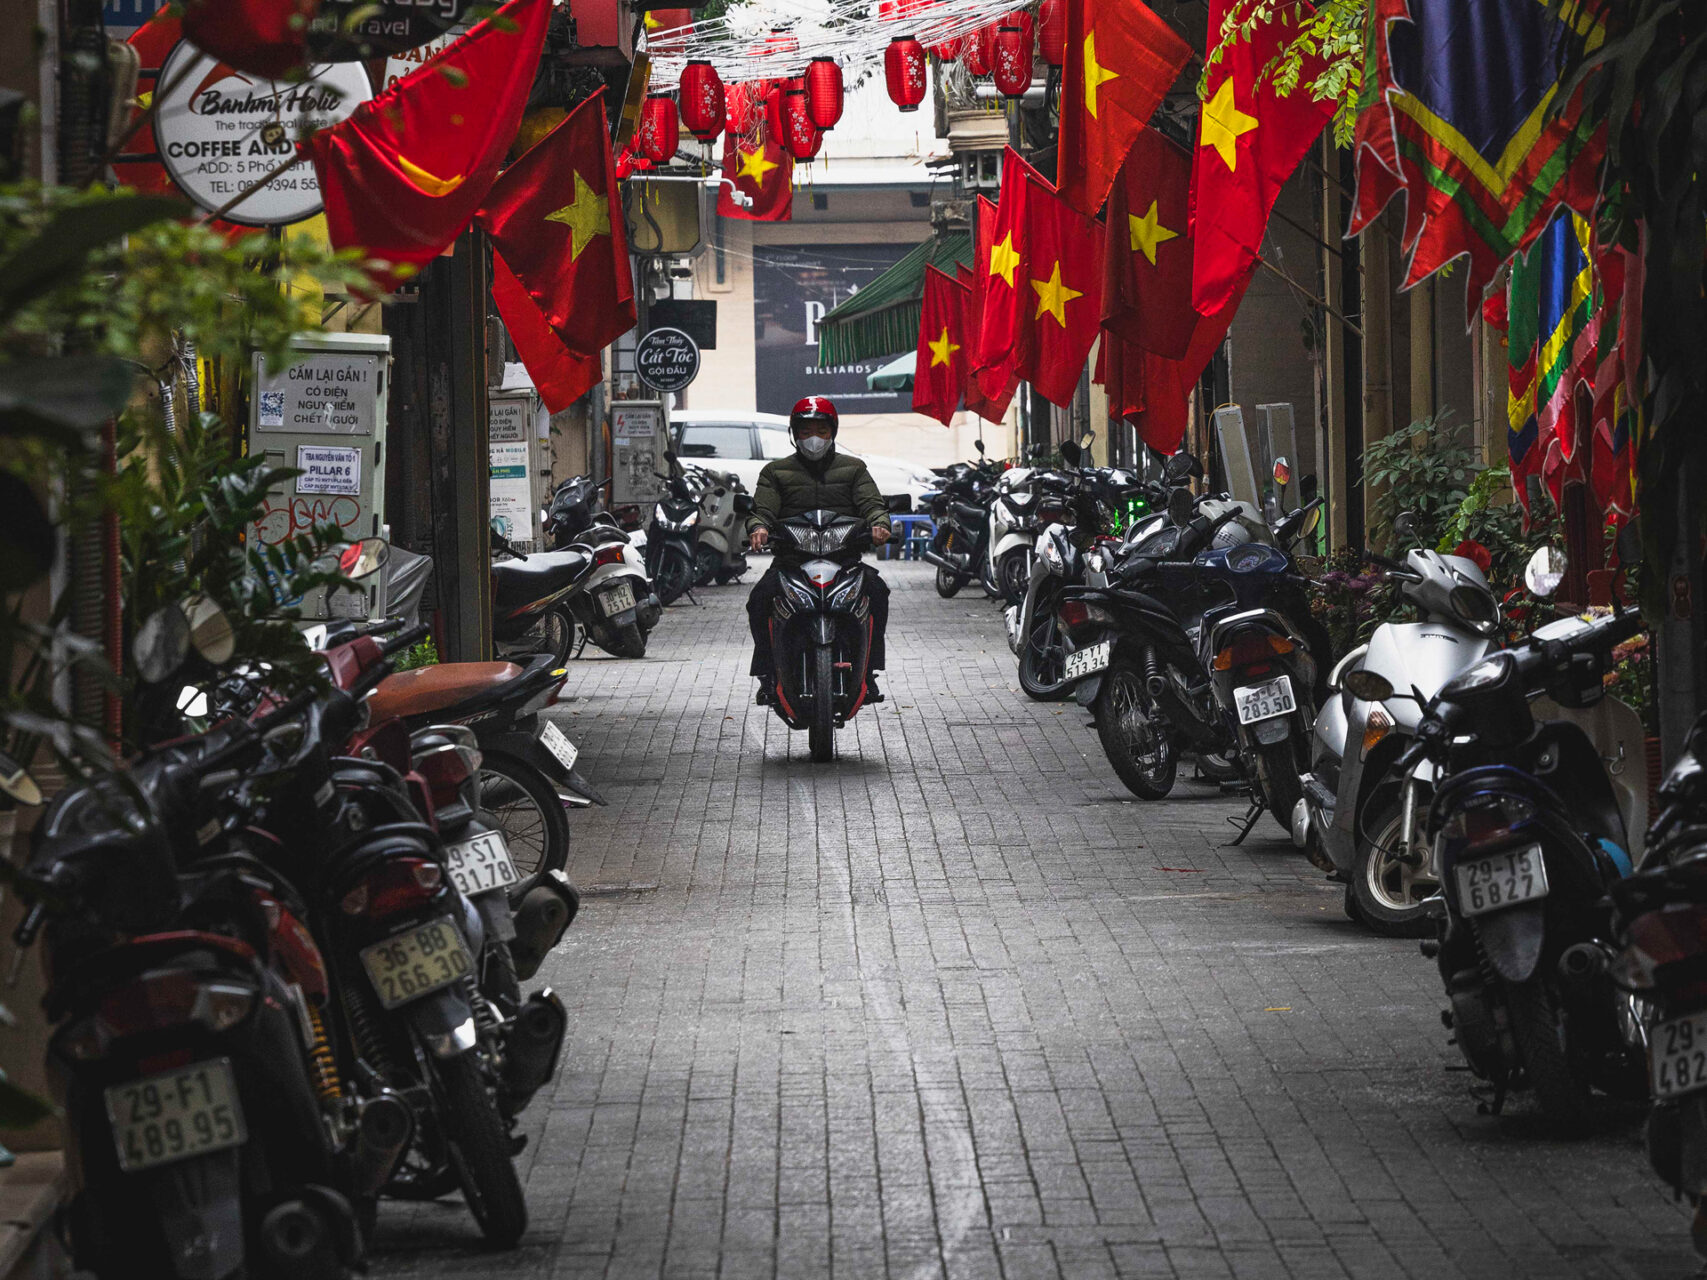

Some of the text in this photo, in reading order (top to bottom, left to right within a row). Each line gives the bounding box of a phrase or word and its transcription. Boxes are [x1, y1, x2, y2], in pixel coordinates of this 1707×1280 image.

[215, 120, 236, 131] The
[167, 140, 242, 159] COFFEE
[197, 162, 233, 174] ADD:
[236, 161, 246, 173] 5
[249, 158, 276, 173] Phố
[209, 180, 234, 193] TEL:
[300, 177, 321, 191] 55
[288, 364, 313, 381] CẤM
[316, 369, 334, 384] LẠI
[805, 365, 872, 375] BILLIARDS
[305, 385, 348, 399] CÓ ĐIỆN
[293, 412, 322, 424] CHẾT
[310, 465, 351, 476] PILLAR 6
[607, 597, 631, 614] 2514
[1071, 645, 1102, 666] 29-Y1
[1066, 656, 1105, 680] 513.34
[1242, 695, 1292, 722] 283.50
[1467, 851, 1533, 888] 29-T5
[1470, 873, 1534, 910] 6827
[382, 949, 468, 1001] 266.30
